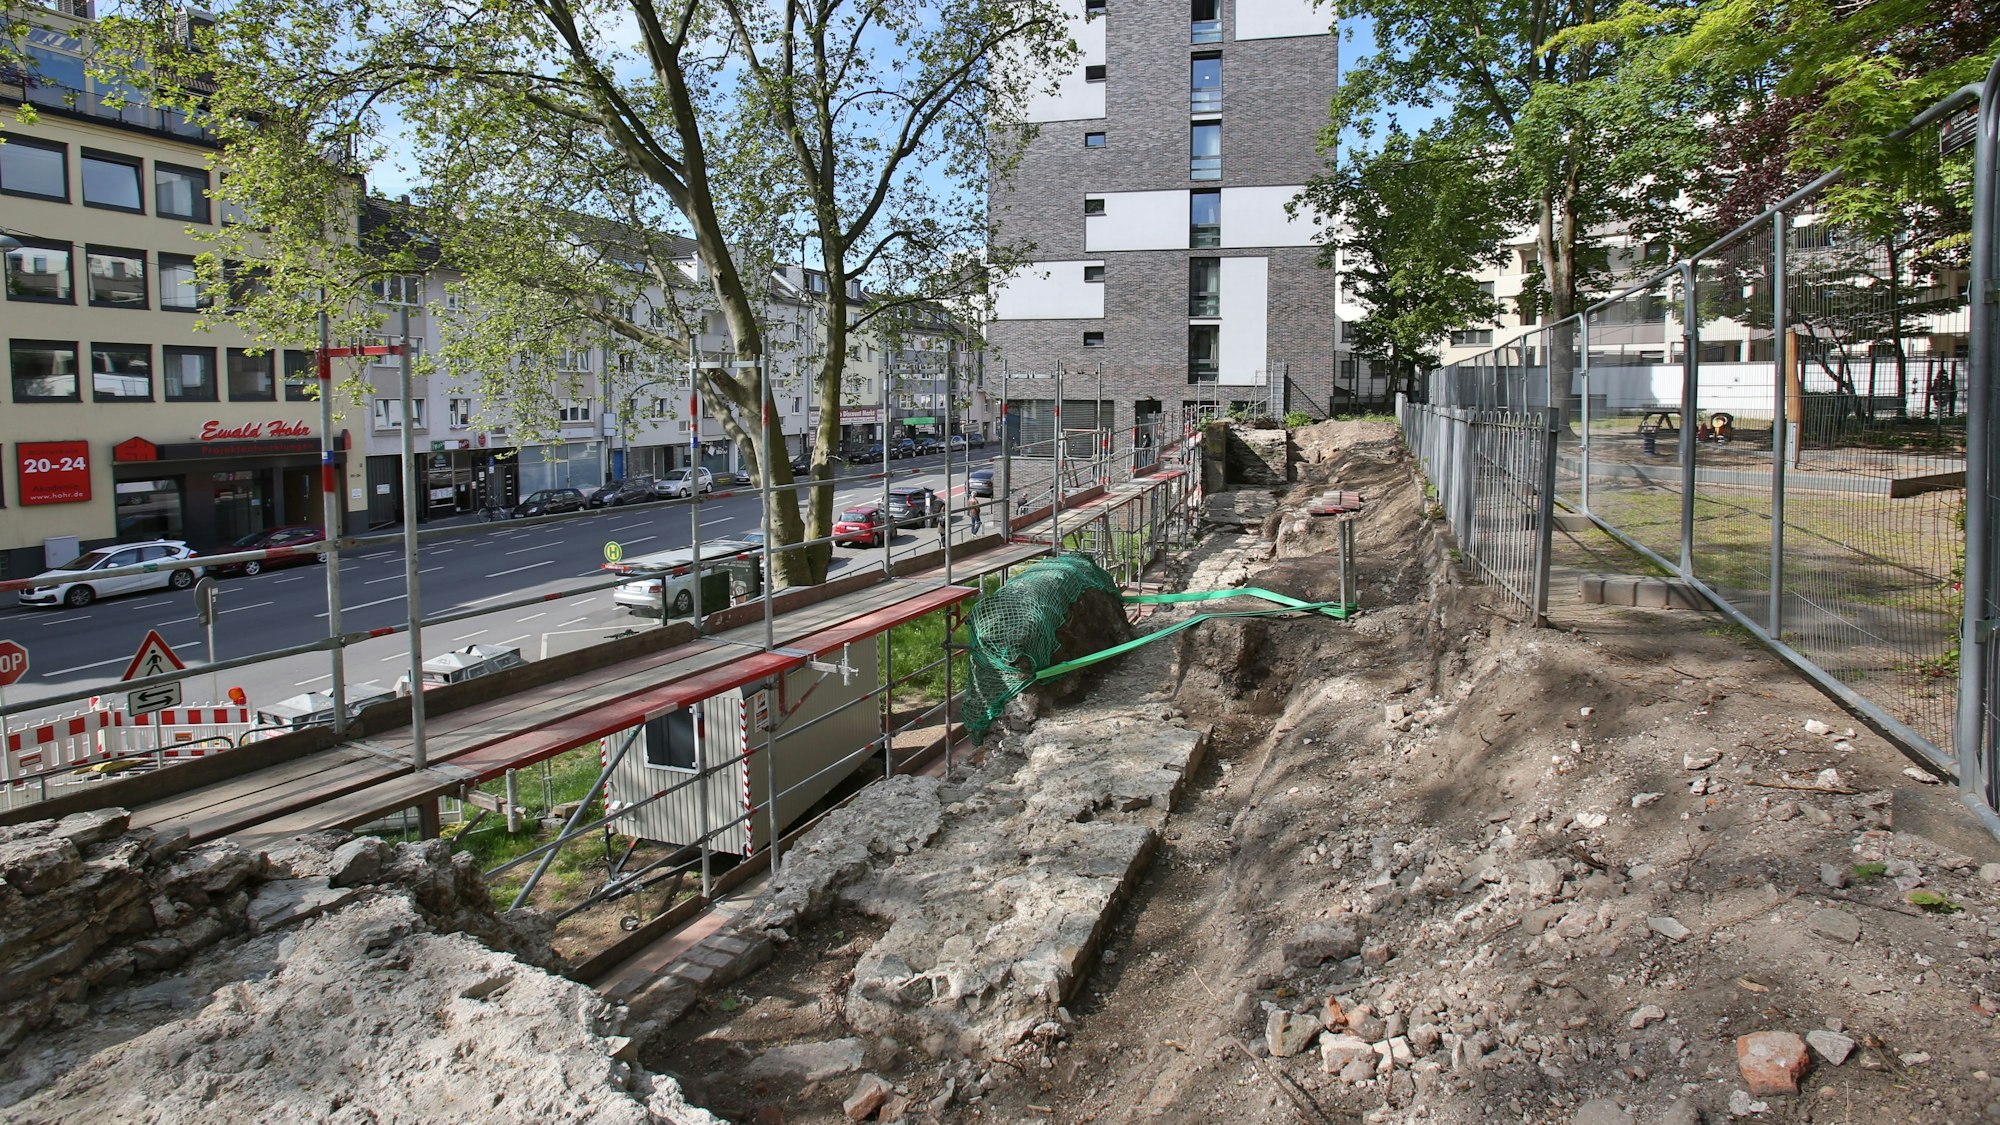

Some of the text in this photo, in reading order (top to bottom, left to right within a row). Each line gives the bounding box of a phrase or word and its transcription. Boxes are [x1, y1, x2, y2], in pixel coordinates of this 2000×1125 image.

[201, 419, 311, 442] Ewald Hohr
[23, 456, 86, 474] 20-24
[30, 491, 84, 500] www.hohr.de
[0, 652, 23, 673] OP
